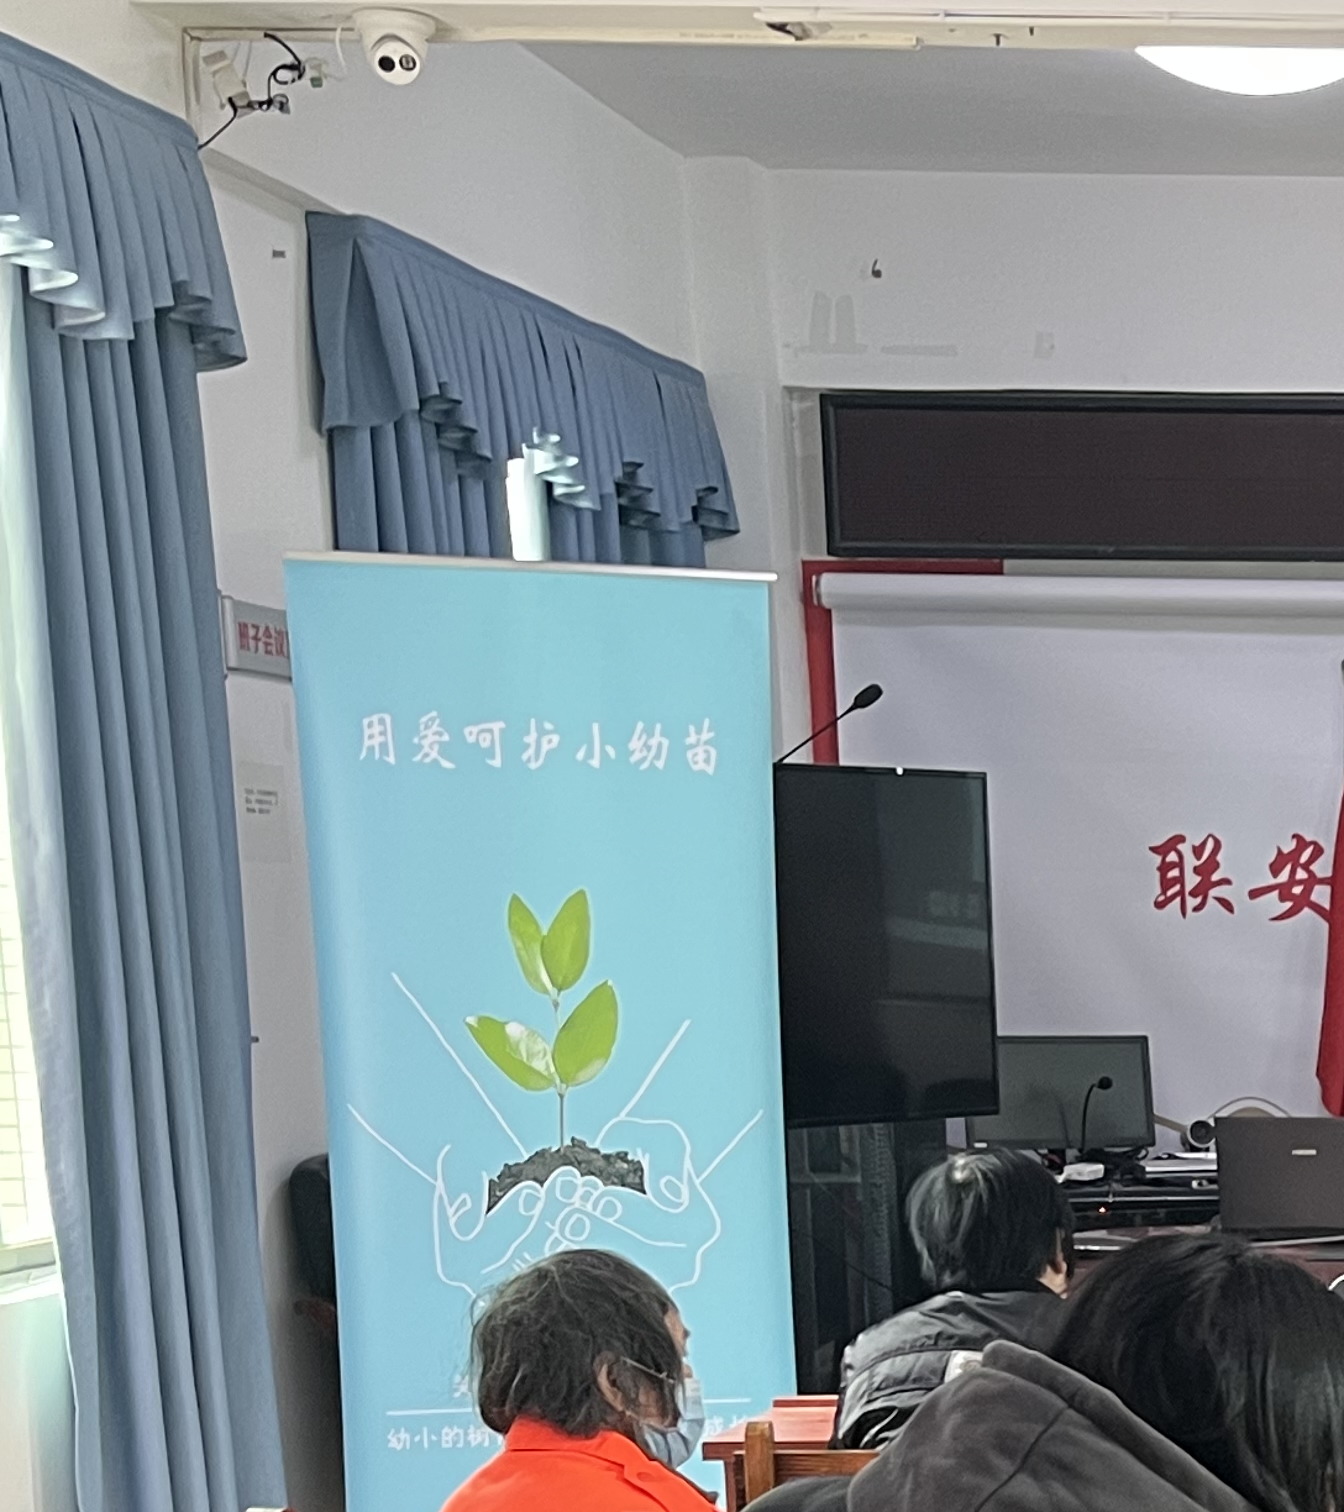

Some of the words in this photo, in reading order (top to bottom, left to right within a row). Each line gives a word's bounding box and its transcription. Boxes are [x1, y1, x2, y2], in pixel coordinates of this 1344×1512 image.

[238, 621, 289, 658] 班子会议
[358, 710, 718, 776] 用爱呵护小幼苗
[387, 1425, 504, 1450] 幼小的树
